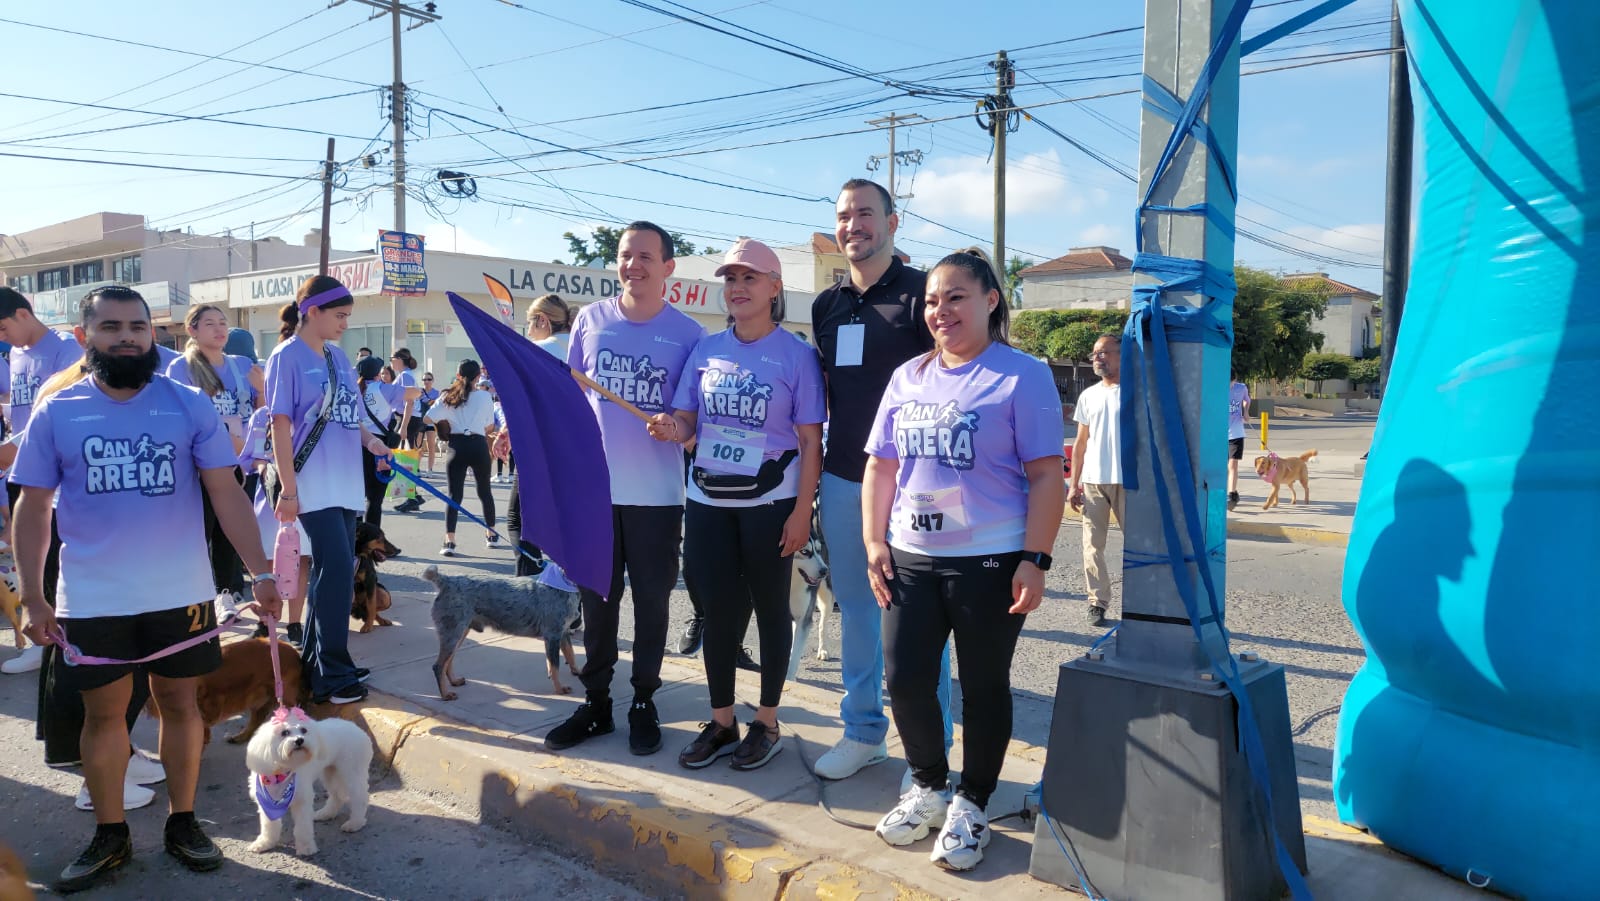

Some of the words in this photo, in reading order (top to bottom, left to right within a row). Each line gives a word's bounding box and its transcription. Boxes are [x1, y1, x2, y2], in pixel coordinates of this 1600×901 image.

[252, 280, 264, 299] LA
[266, 276, 294, 298] CASA
[328, 262, 371, 290] OSHI
[510, 269, 535, 290] LA
[544, 272, 595, 296] CASA
[598, 350, 636, 379] CAN
[596, 376, 664, 405] RRERA
[702, 369, 740, 394] CAN
[703, 393, 767, 421] RRERA
[898, 401, 936, 428] CAN
[84, 436, 135, 466] CAN
[712, 443, 745, 463] 108
[897, 427, 973, 460] RRERA
[87, 460, 175, 492] RRERA
[911, 512, 943, 531] 247
[982, 558, 1000, 568] alo
[187, 601, 210, 632] 27
